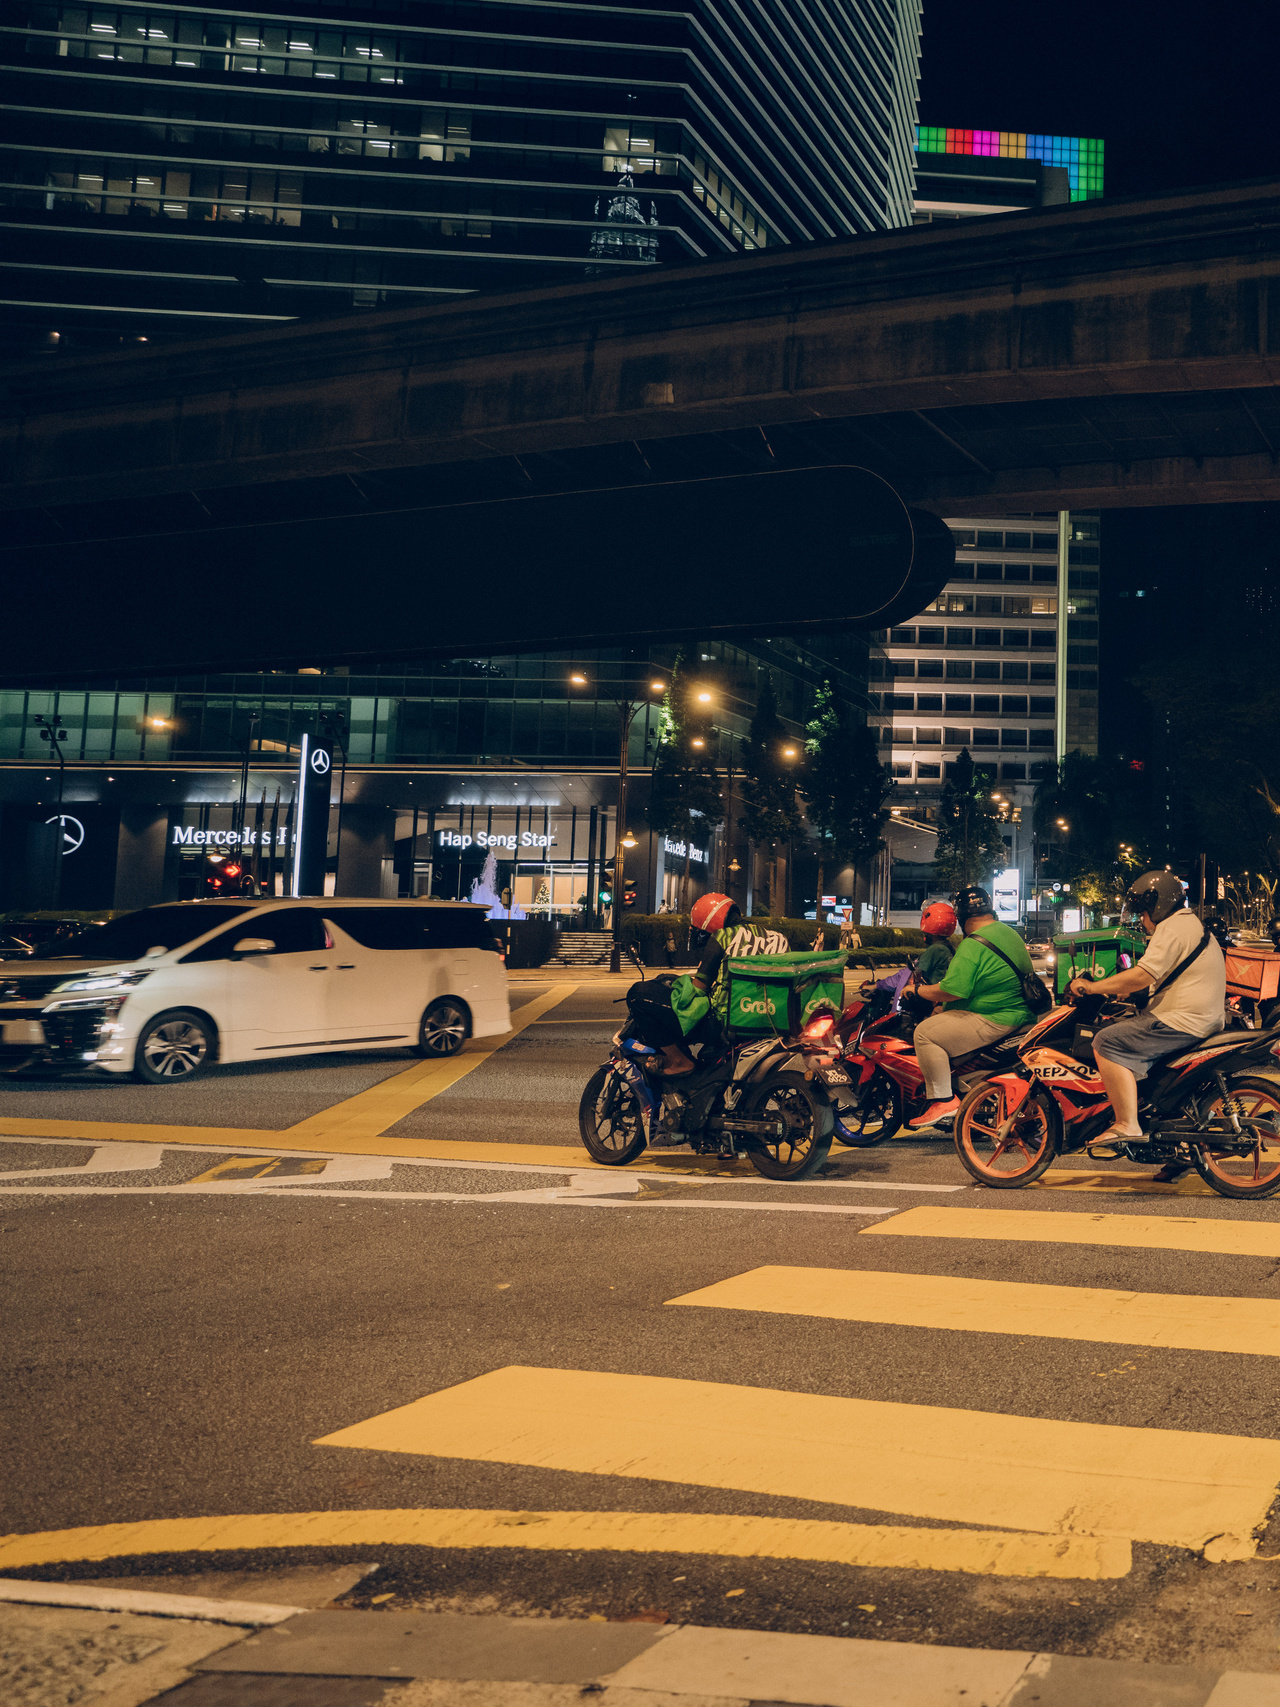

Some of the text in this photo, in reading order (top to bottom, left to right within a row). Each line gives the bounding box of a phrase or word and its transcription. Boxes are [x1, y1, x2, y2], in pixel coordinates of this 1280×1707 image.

[440, 831, 555, 850] Hap Seng Star
[740, 997, 776, 1016] Grab
